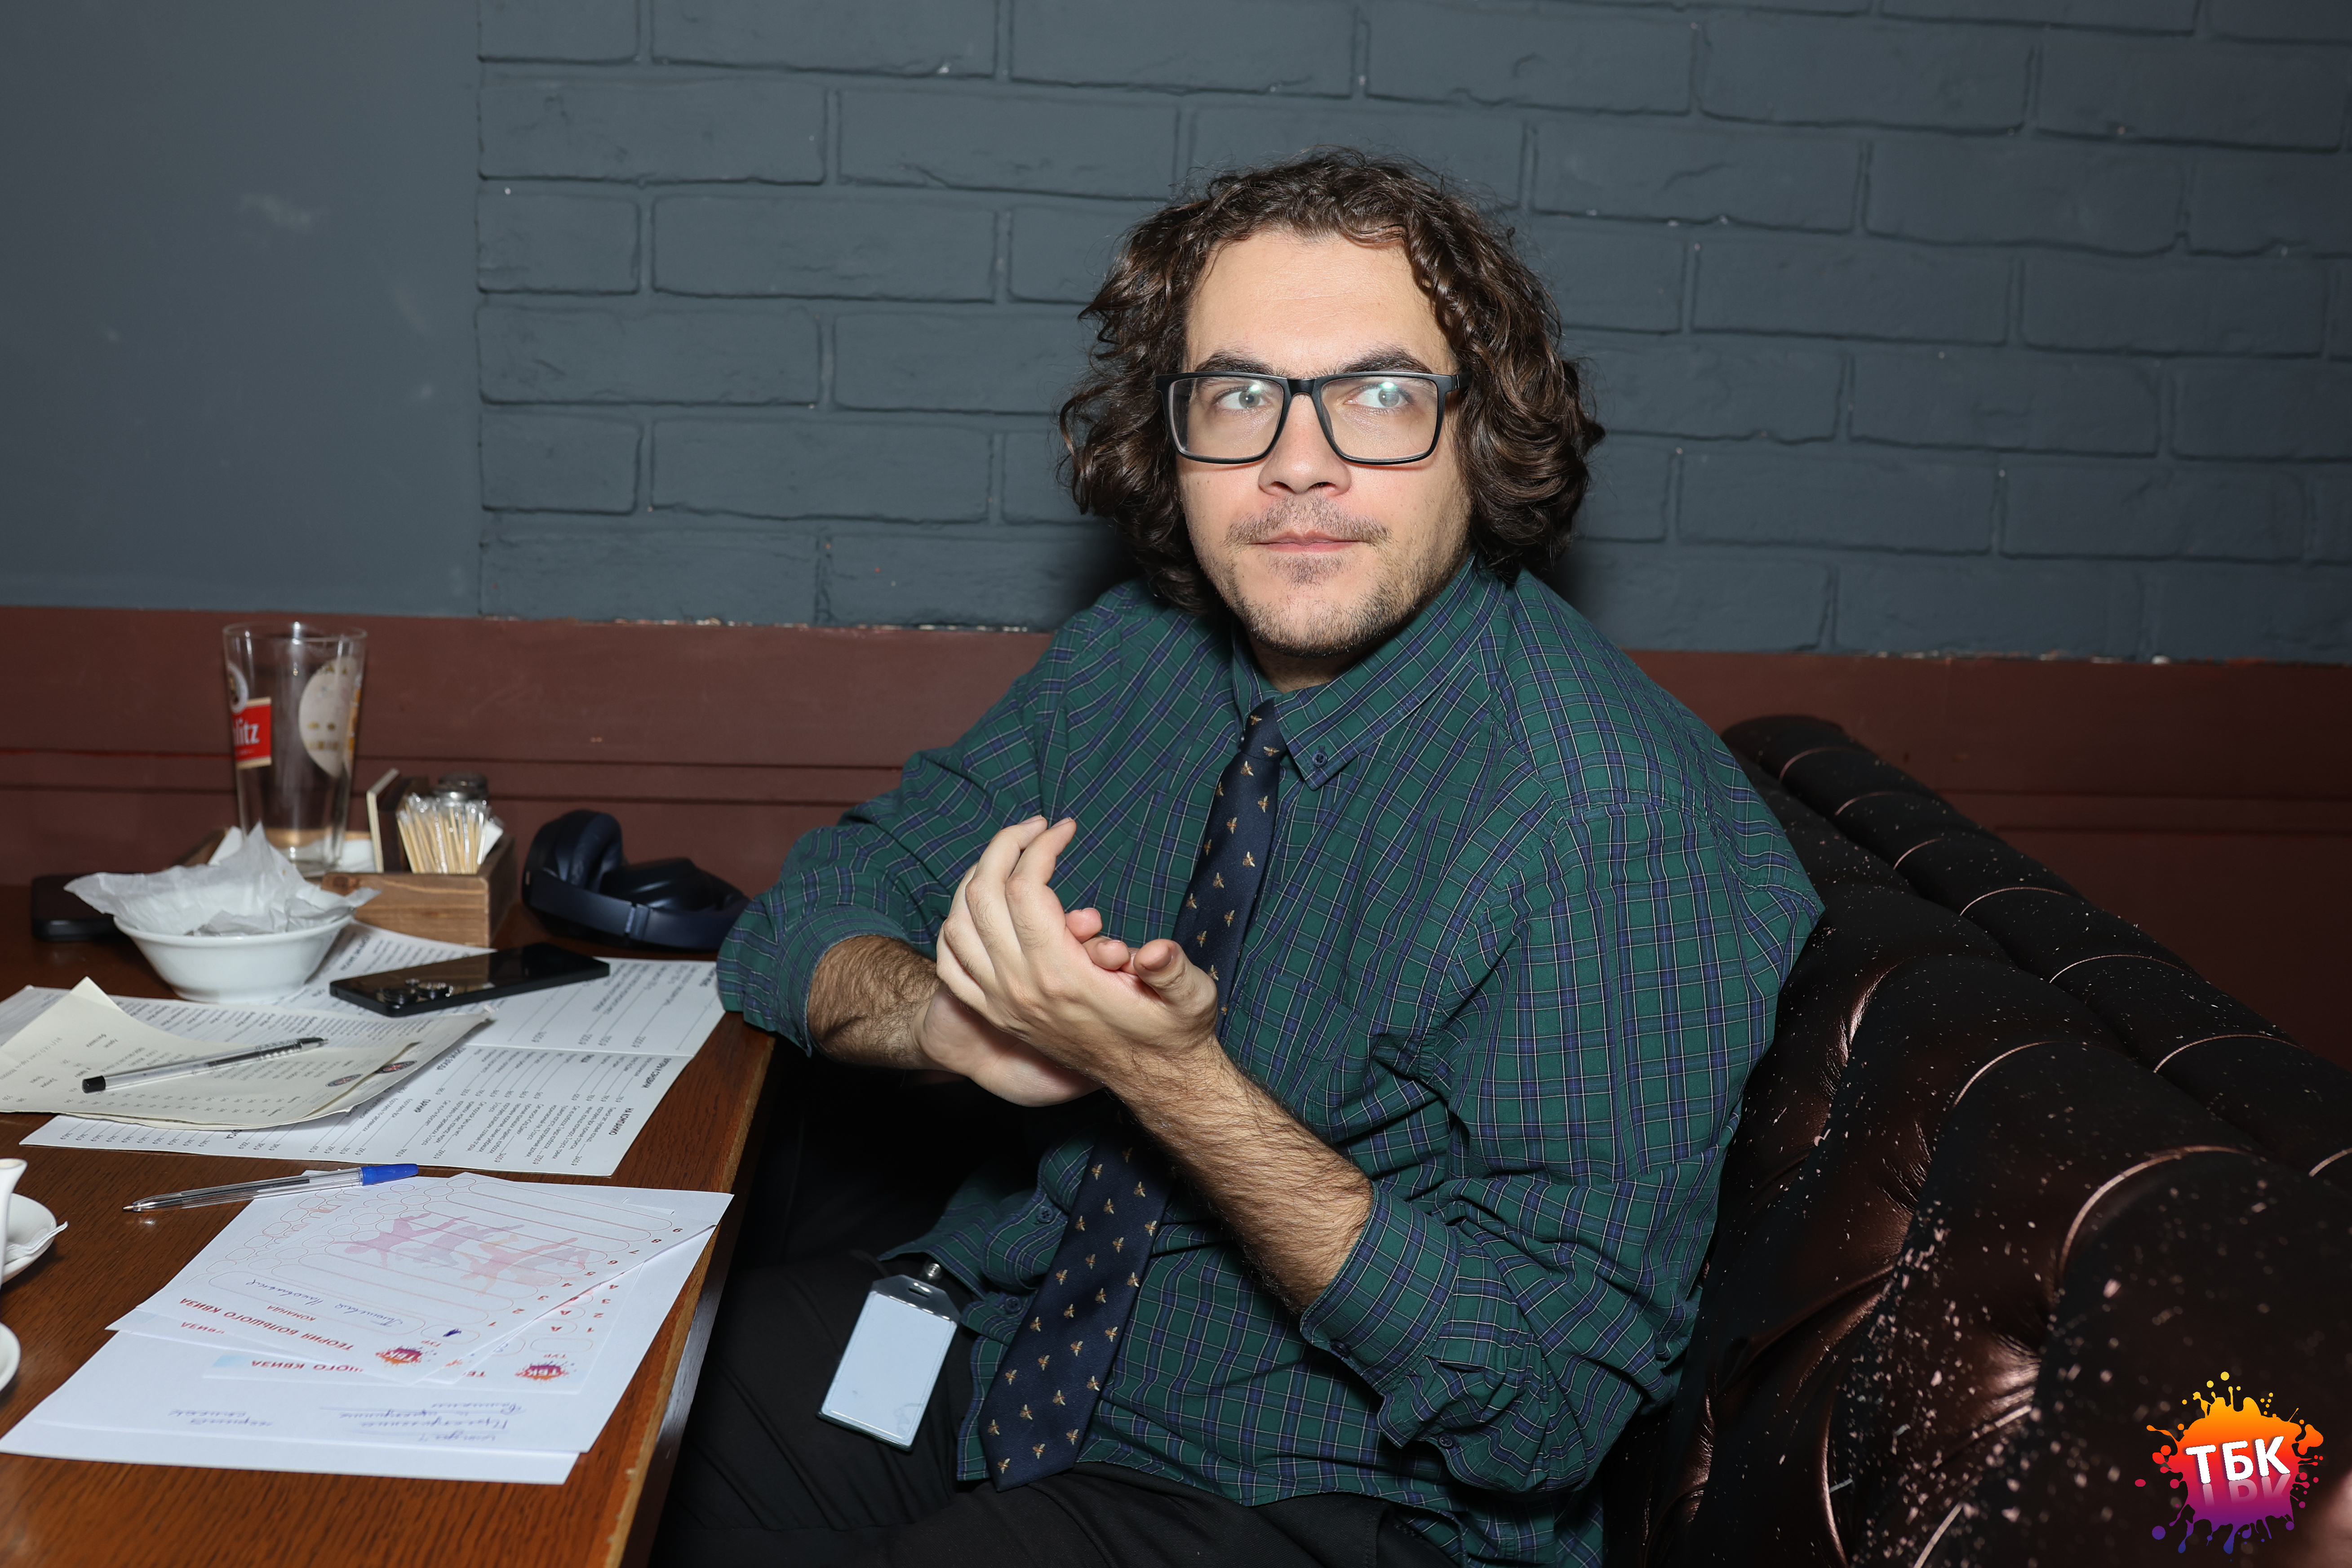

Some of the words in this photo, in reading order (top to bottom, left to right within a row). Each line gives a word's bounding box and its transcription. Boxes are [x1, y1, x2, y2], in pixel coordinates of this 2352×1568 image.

[233, 717, 260, 746] litz
[414, 1099, 431, 1113] ГАРНИР
[608, 1113, 630, 1135] КОМПАНИЮ
[495, 1152, 507, 1160] 3400
[572, 1155, 582, 1164] 2400
[179, 1298, 222, 1314] КВИЗА
[266, 1305, 316, 1322] КОМАНДА
[223, 1311, 299, 1336] БОЛЬШОГО
[300, 1333, 355, 1351] ТЕОРИЯ
[251, 1360, 306, 1370] КВИЗА
